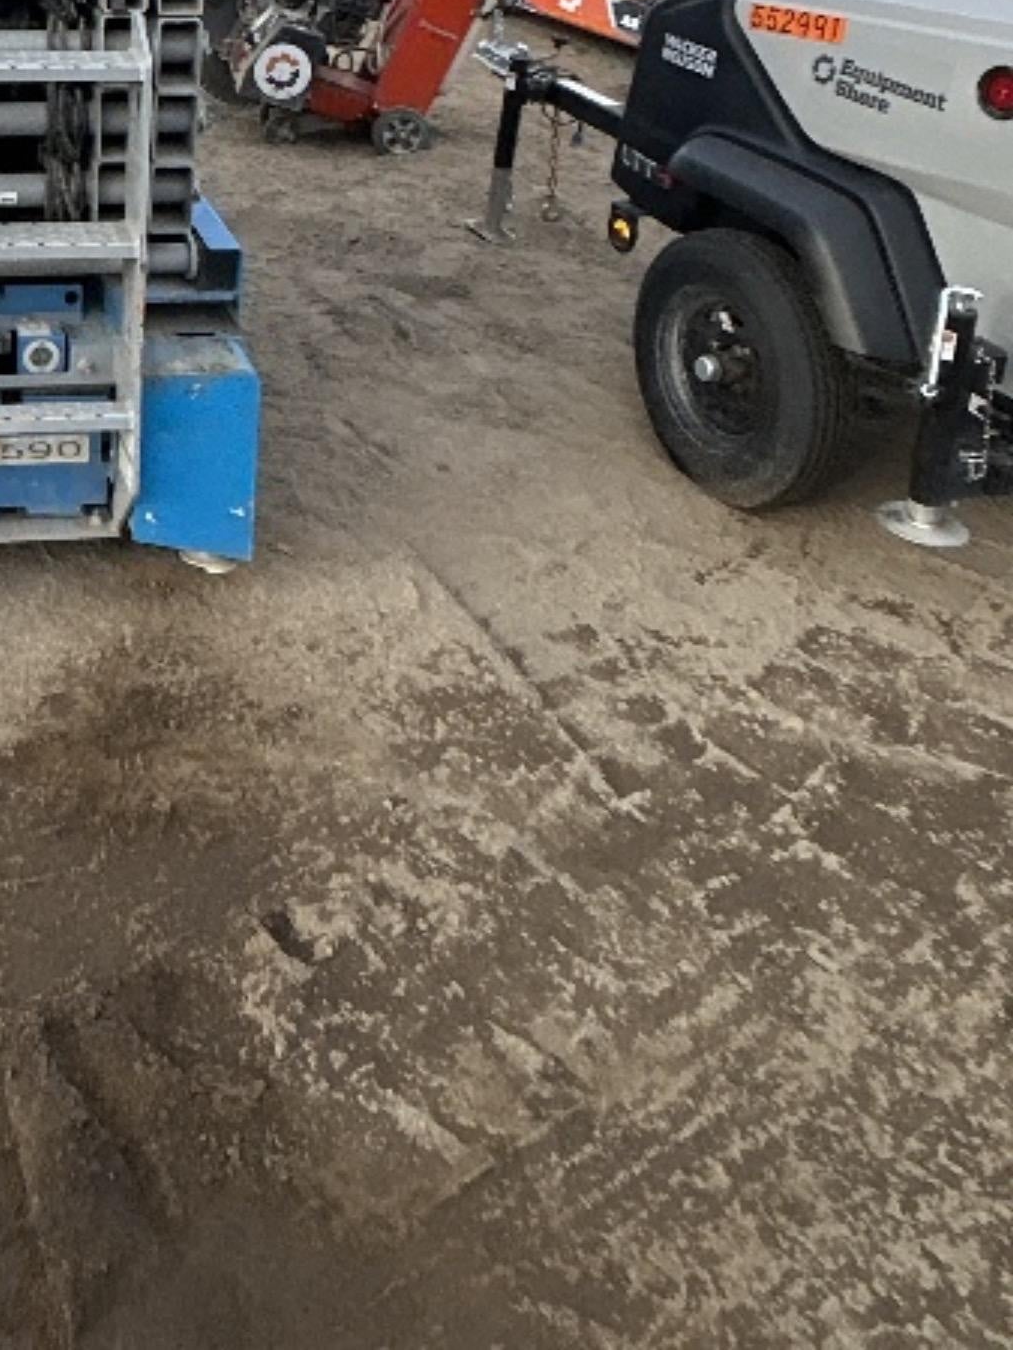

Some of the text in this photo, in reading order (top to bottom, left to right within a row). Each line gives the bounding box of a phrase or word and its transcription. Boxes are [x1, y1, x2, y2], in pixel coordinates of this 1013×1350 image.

[750, 3, 840, 40] 552991
[835, 79, 891, 114] Share
[840, 58, 947, 111] Equipment
